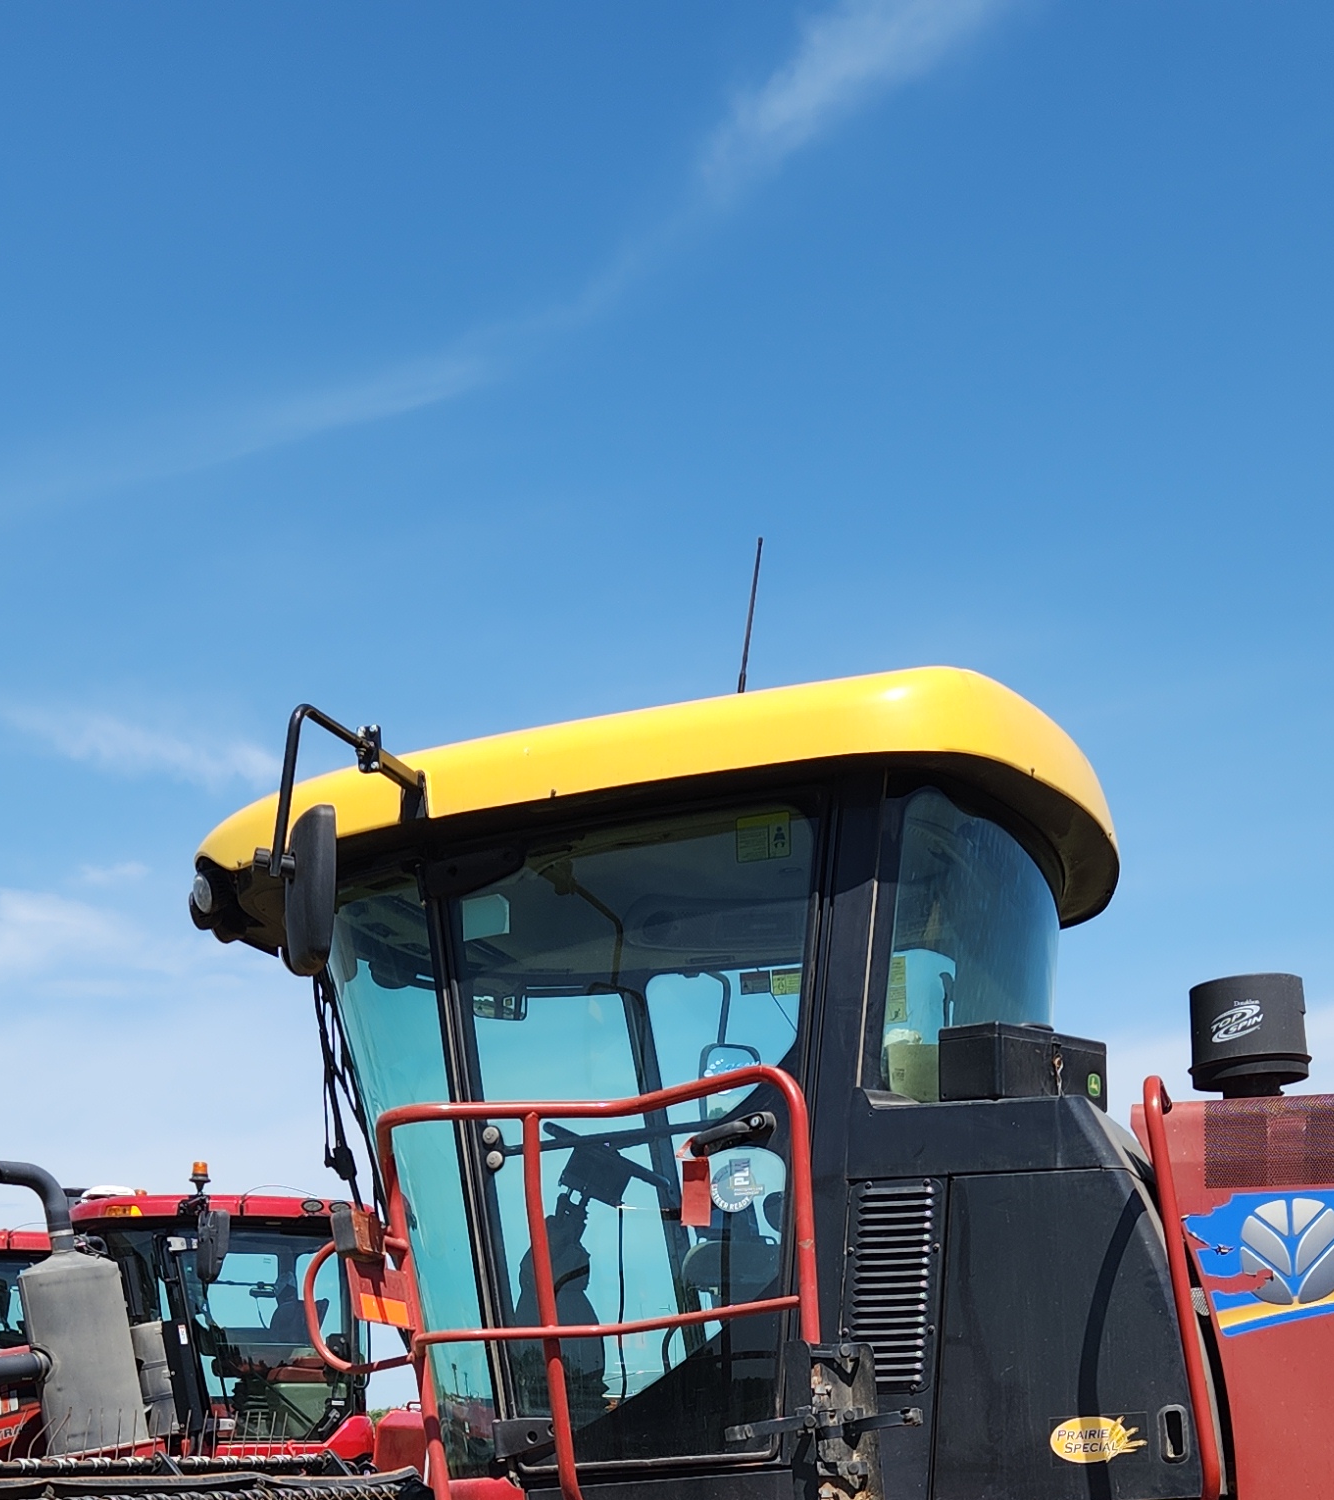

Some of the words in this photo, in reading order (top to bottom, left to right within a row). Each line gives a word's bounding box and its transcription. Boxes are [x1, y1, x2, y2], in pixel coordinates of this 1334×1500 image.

[1210, 1011, 1243, 1033] TOP
[1227, 1012, 1264, 1035] SPIN
[729, 1196, 751, 1211] READY
[1056, 1429, 1110, 1442] PRAIRIE
[1064, 1441, 1119, 1455] SPECIAL
